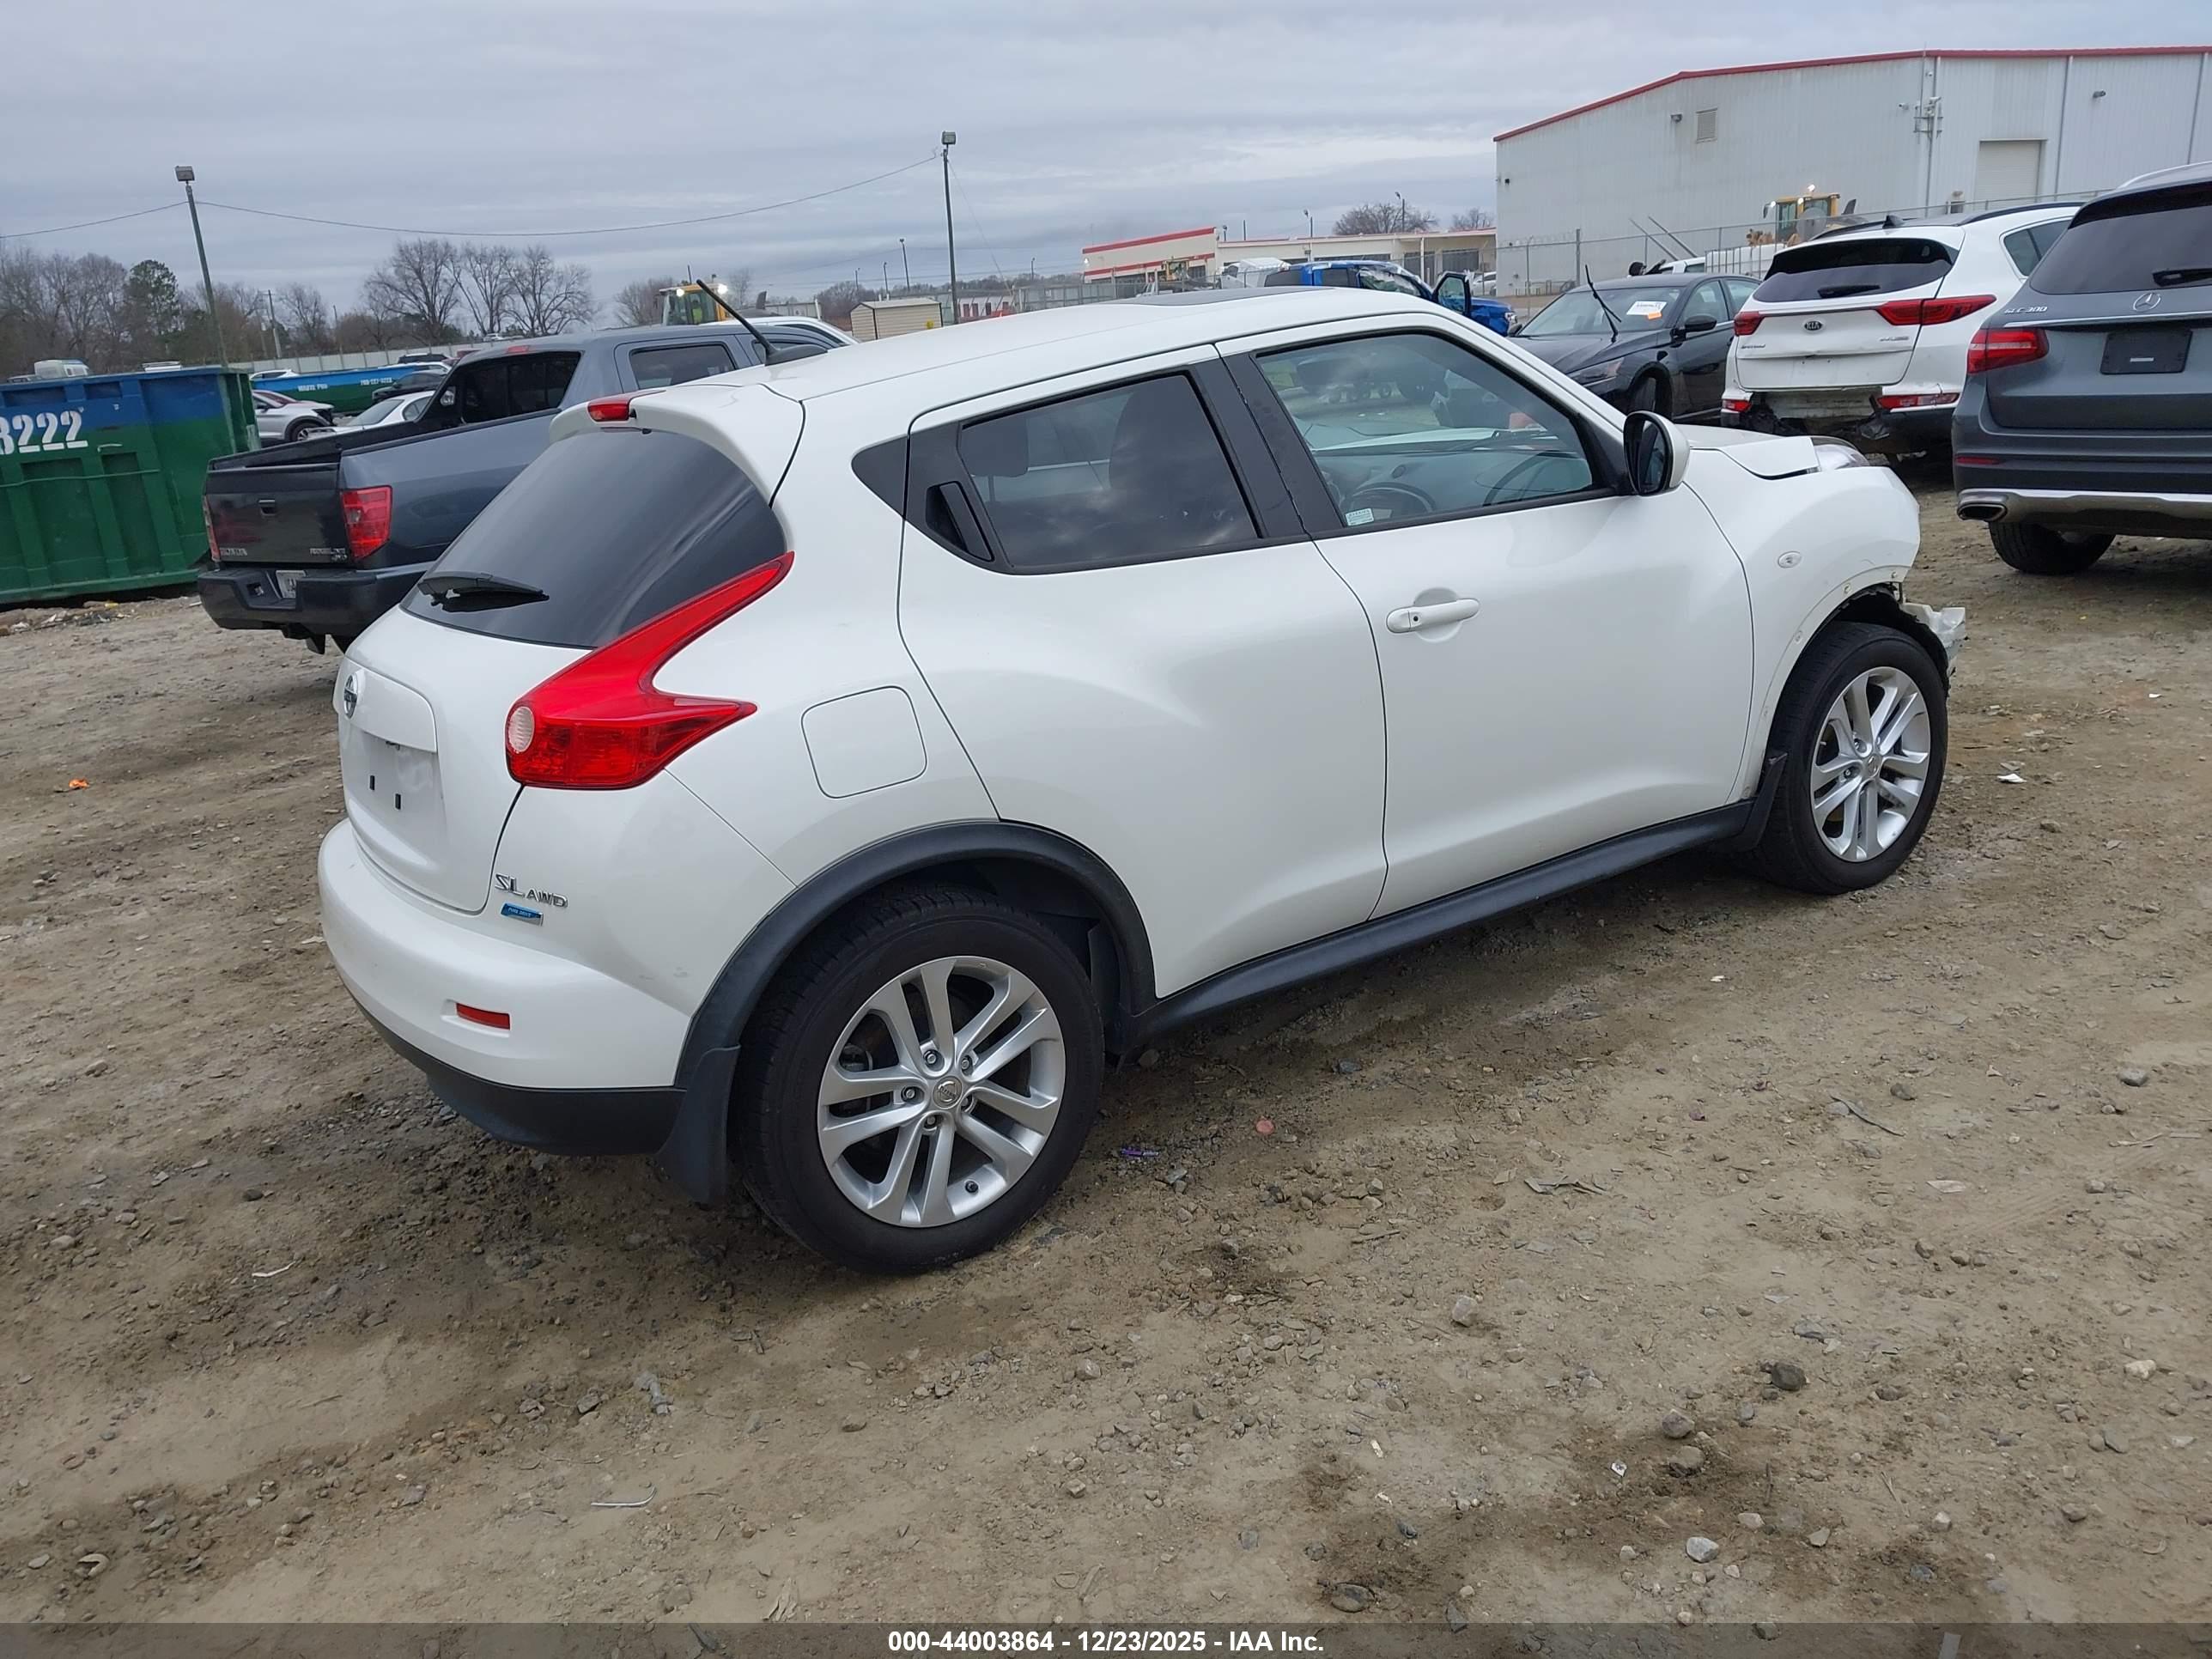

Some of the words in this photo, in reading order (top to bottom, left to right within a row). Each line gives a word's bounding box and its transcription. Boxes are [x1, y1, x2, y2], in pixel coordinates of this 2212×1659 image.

[1805, 321, 1820, 330] KIA
[495, 872, 525, 898] SL
[524, 887, 568, 908] AWD
